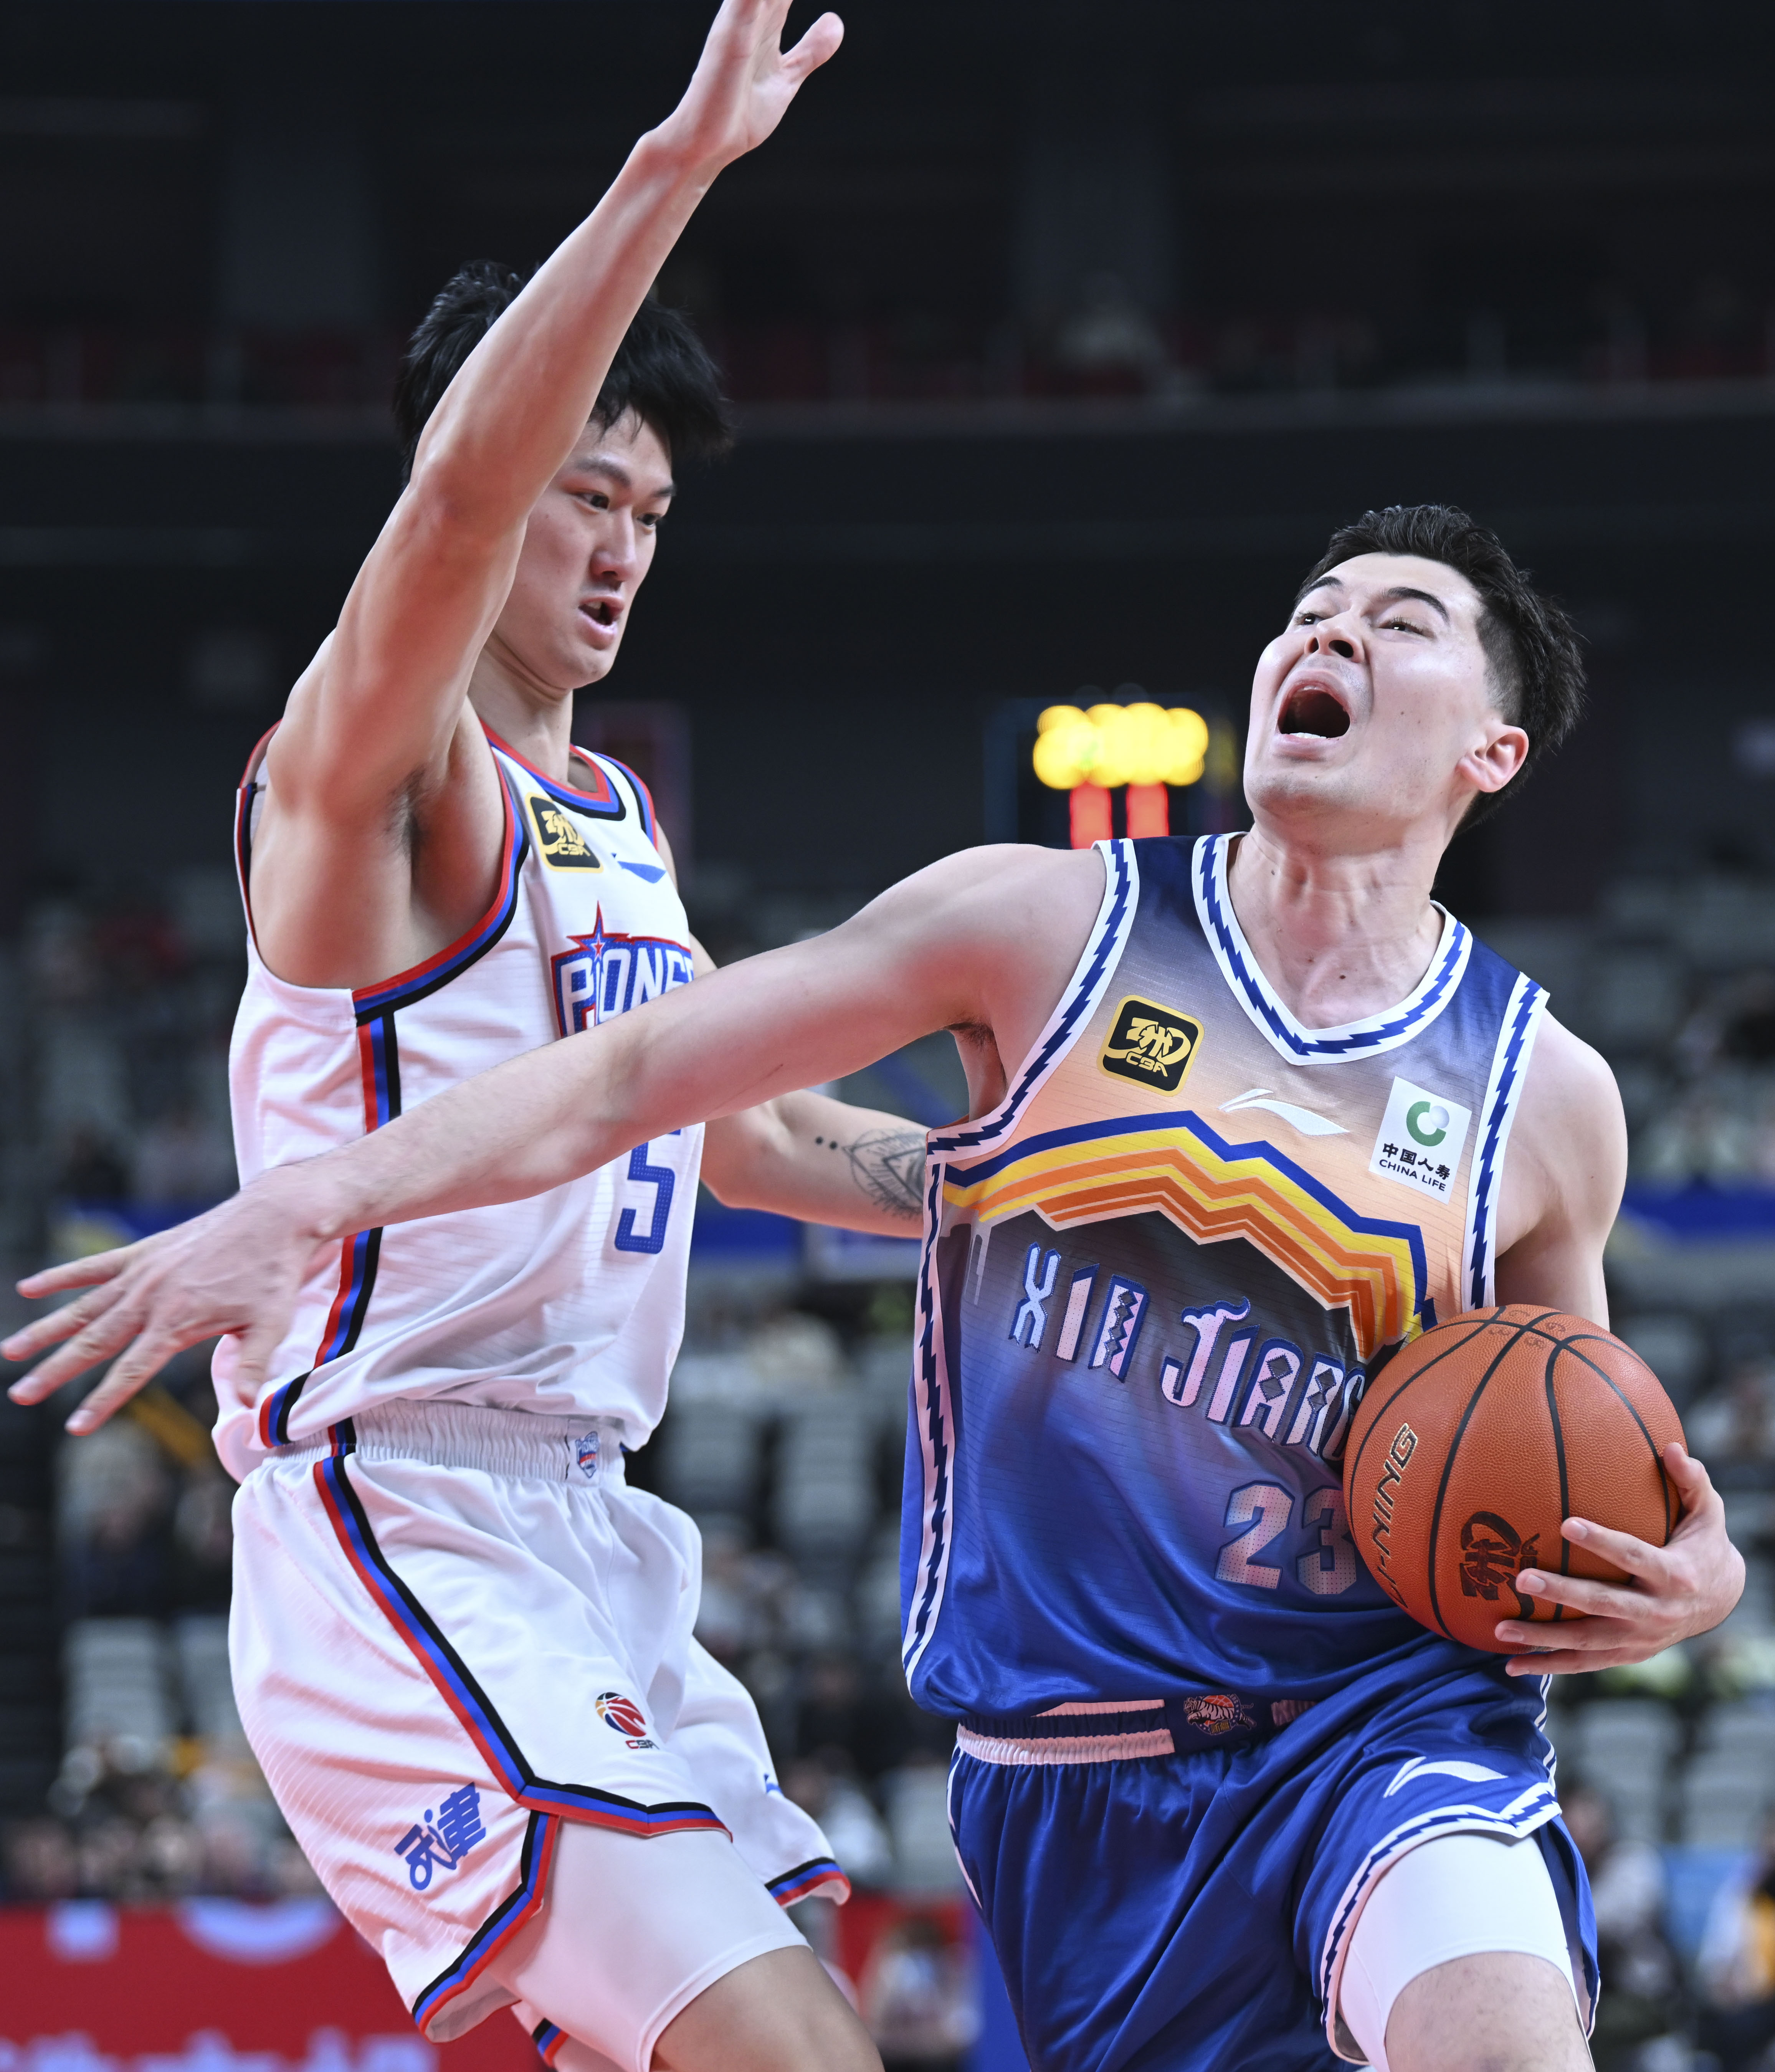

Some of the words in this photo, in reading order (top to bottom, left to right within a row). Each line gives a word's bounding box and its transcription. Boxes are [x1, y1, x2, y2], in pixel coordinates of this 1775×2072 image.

[558, 843, 591, 857] CBA
[1126, 1051, 1168, 1077] CBA
[1379, 1159, 1417, 1179] CHINA
[1421, 1174, 1446, 1192] LIFE
[1382, 1143, 1450, 1180] 中国人寿
[615, 1128, 681, 1254] 5
[1214, 1480, 1357, 1595] 23
[1519, 1533, 1540, 1573] BA
[625, 1740, 660, 1750] CBA
